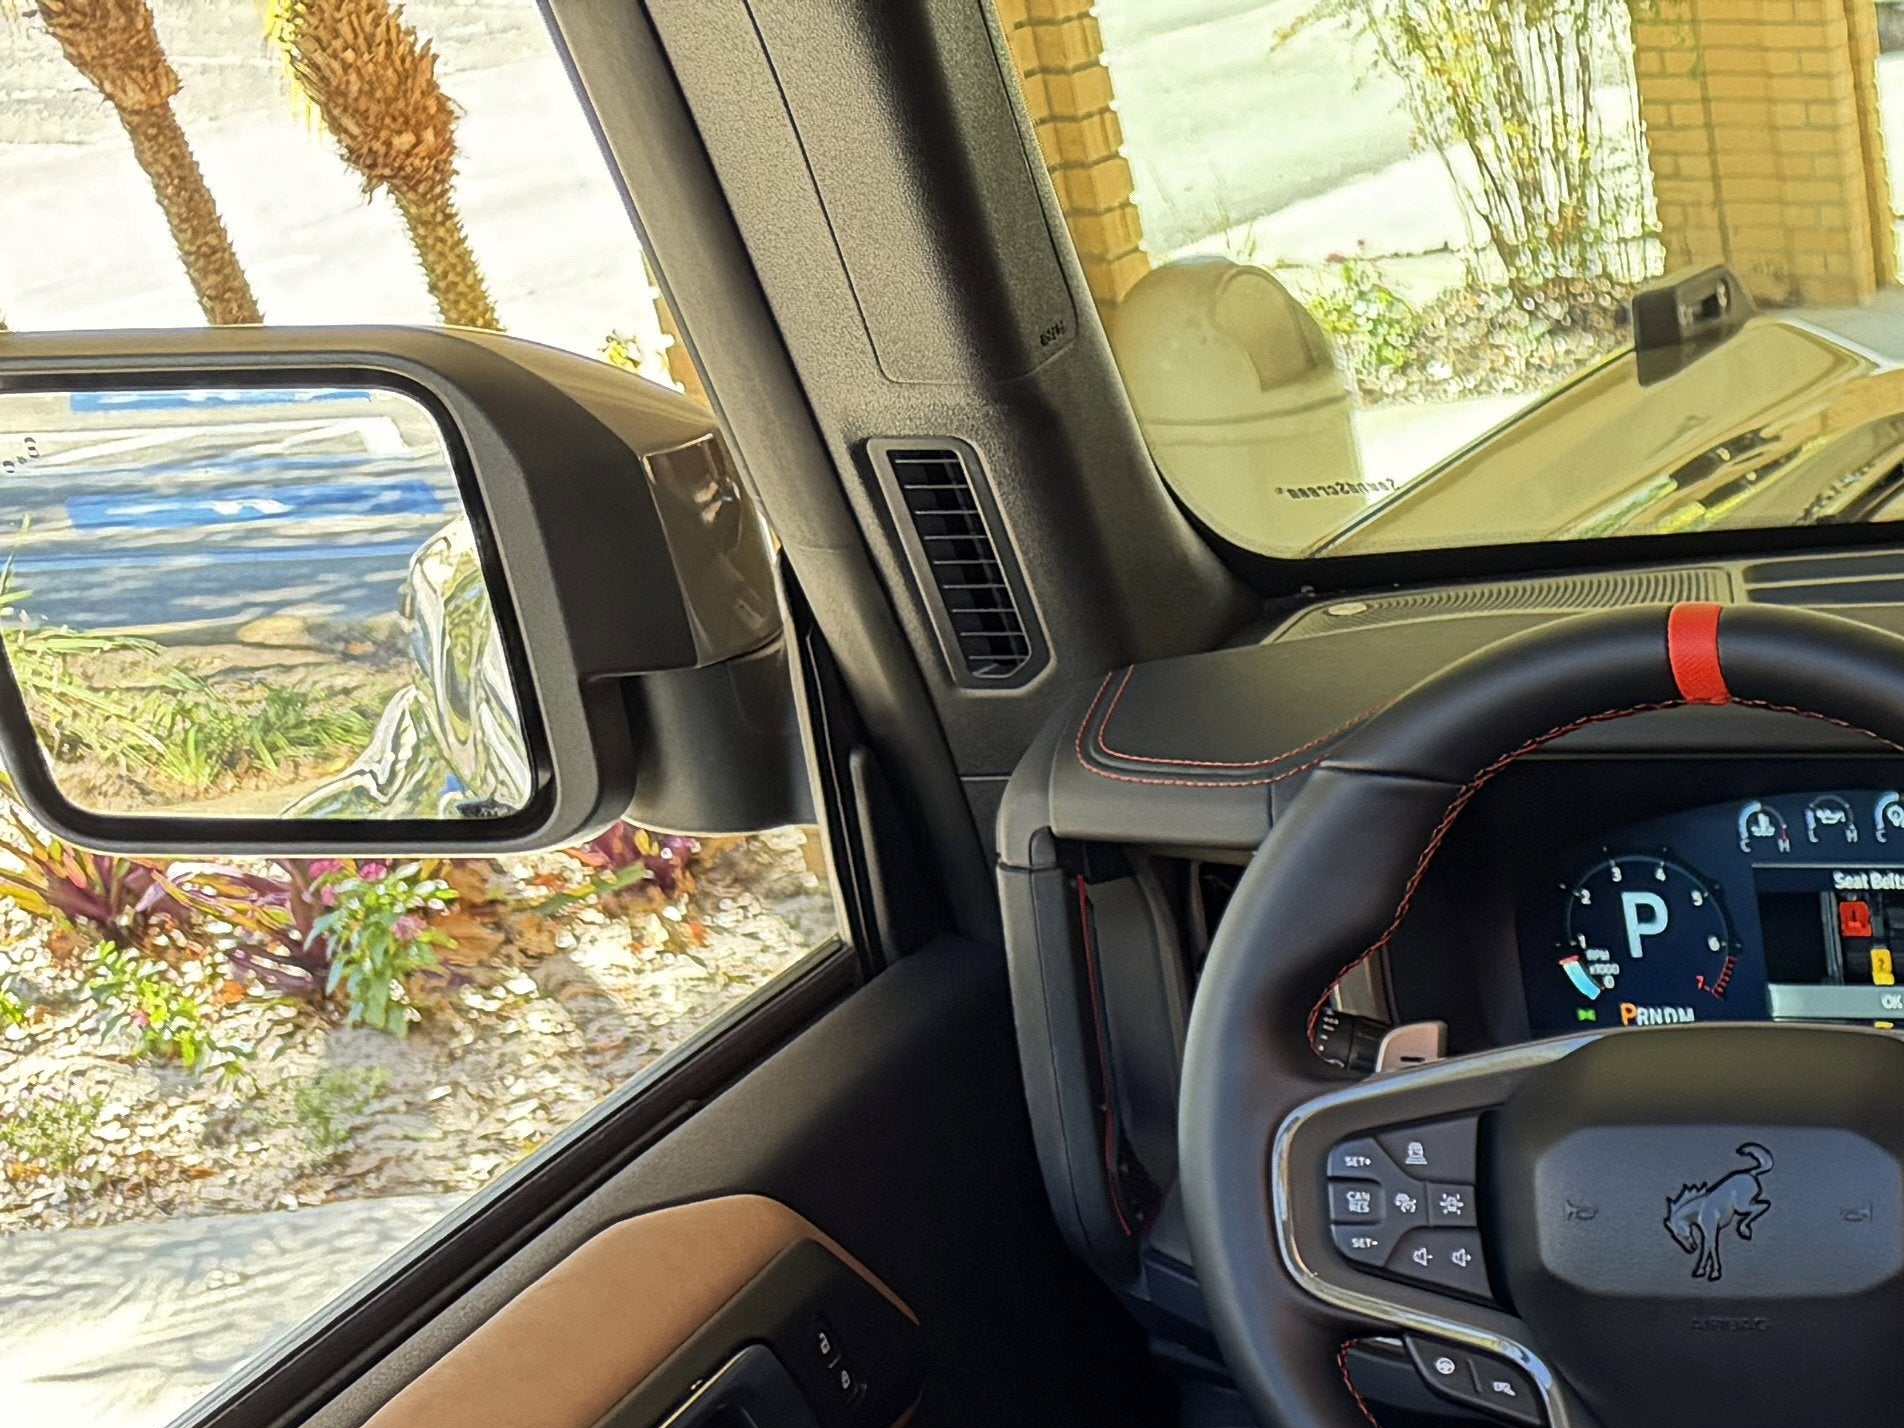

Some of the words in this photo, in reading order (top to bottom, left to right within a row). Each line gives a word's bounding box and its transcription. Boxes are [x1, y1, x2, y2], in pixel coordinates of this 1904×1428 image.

[1612, 866, 1622, 882] 3
[1655, 867, 1666, 882] 4
[1832, 871, 1869, 890] Seat
[1580, 889, 1591, 905] 2
[1621, 891, 1669, 958] P
[1881, 993, 1904, 1010] OK
[1346, 1191, 1370, 1201] CAN
